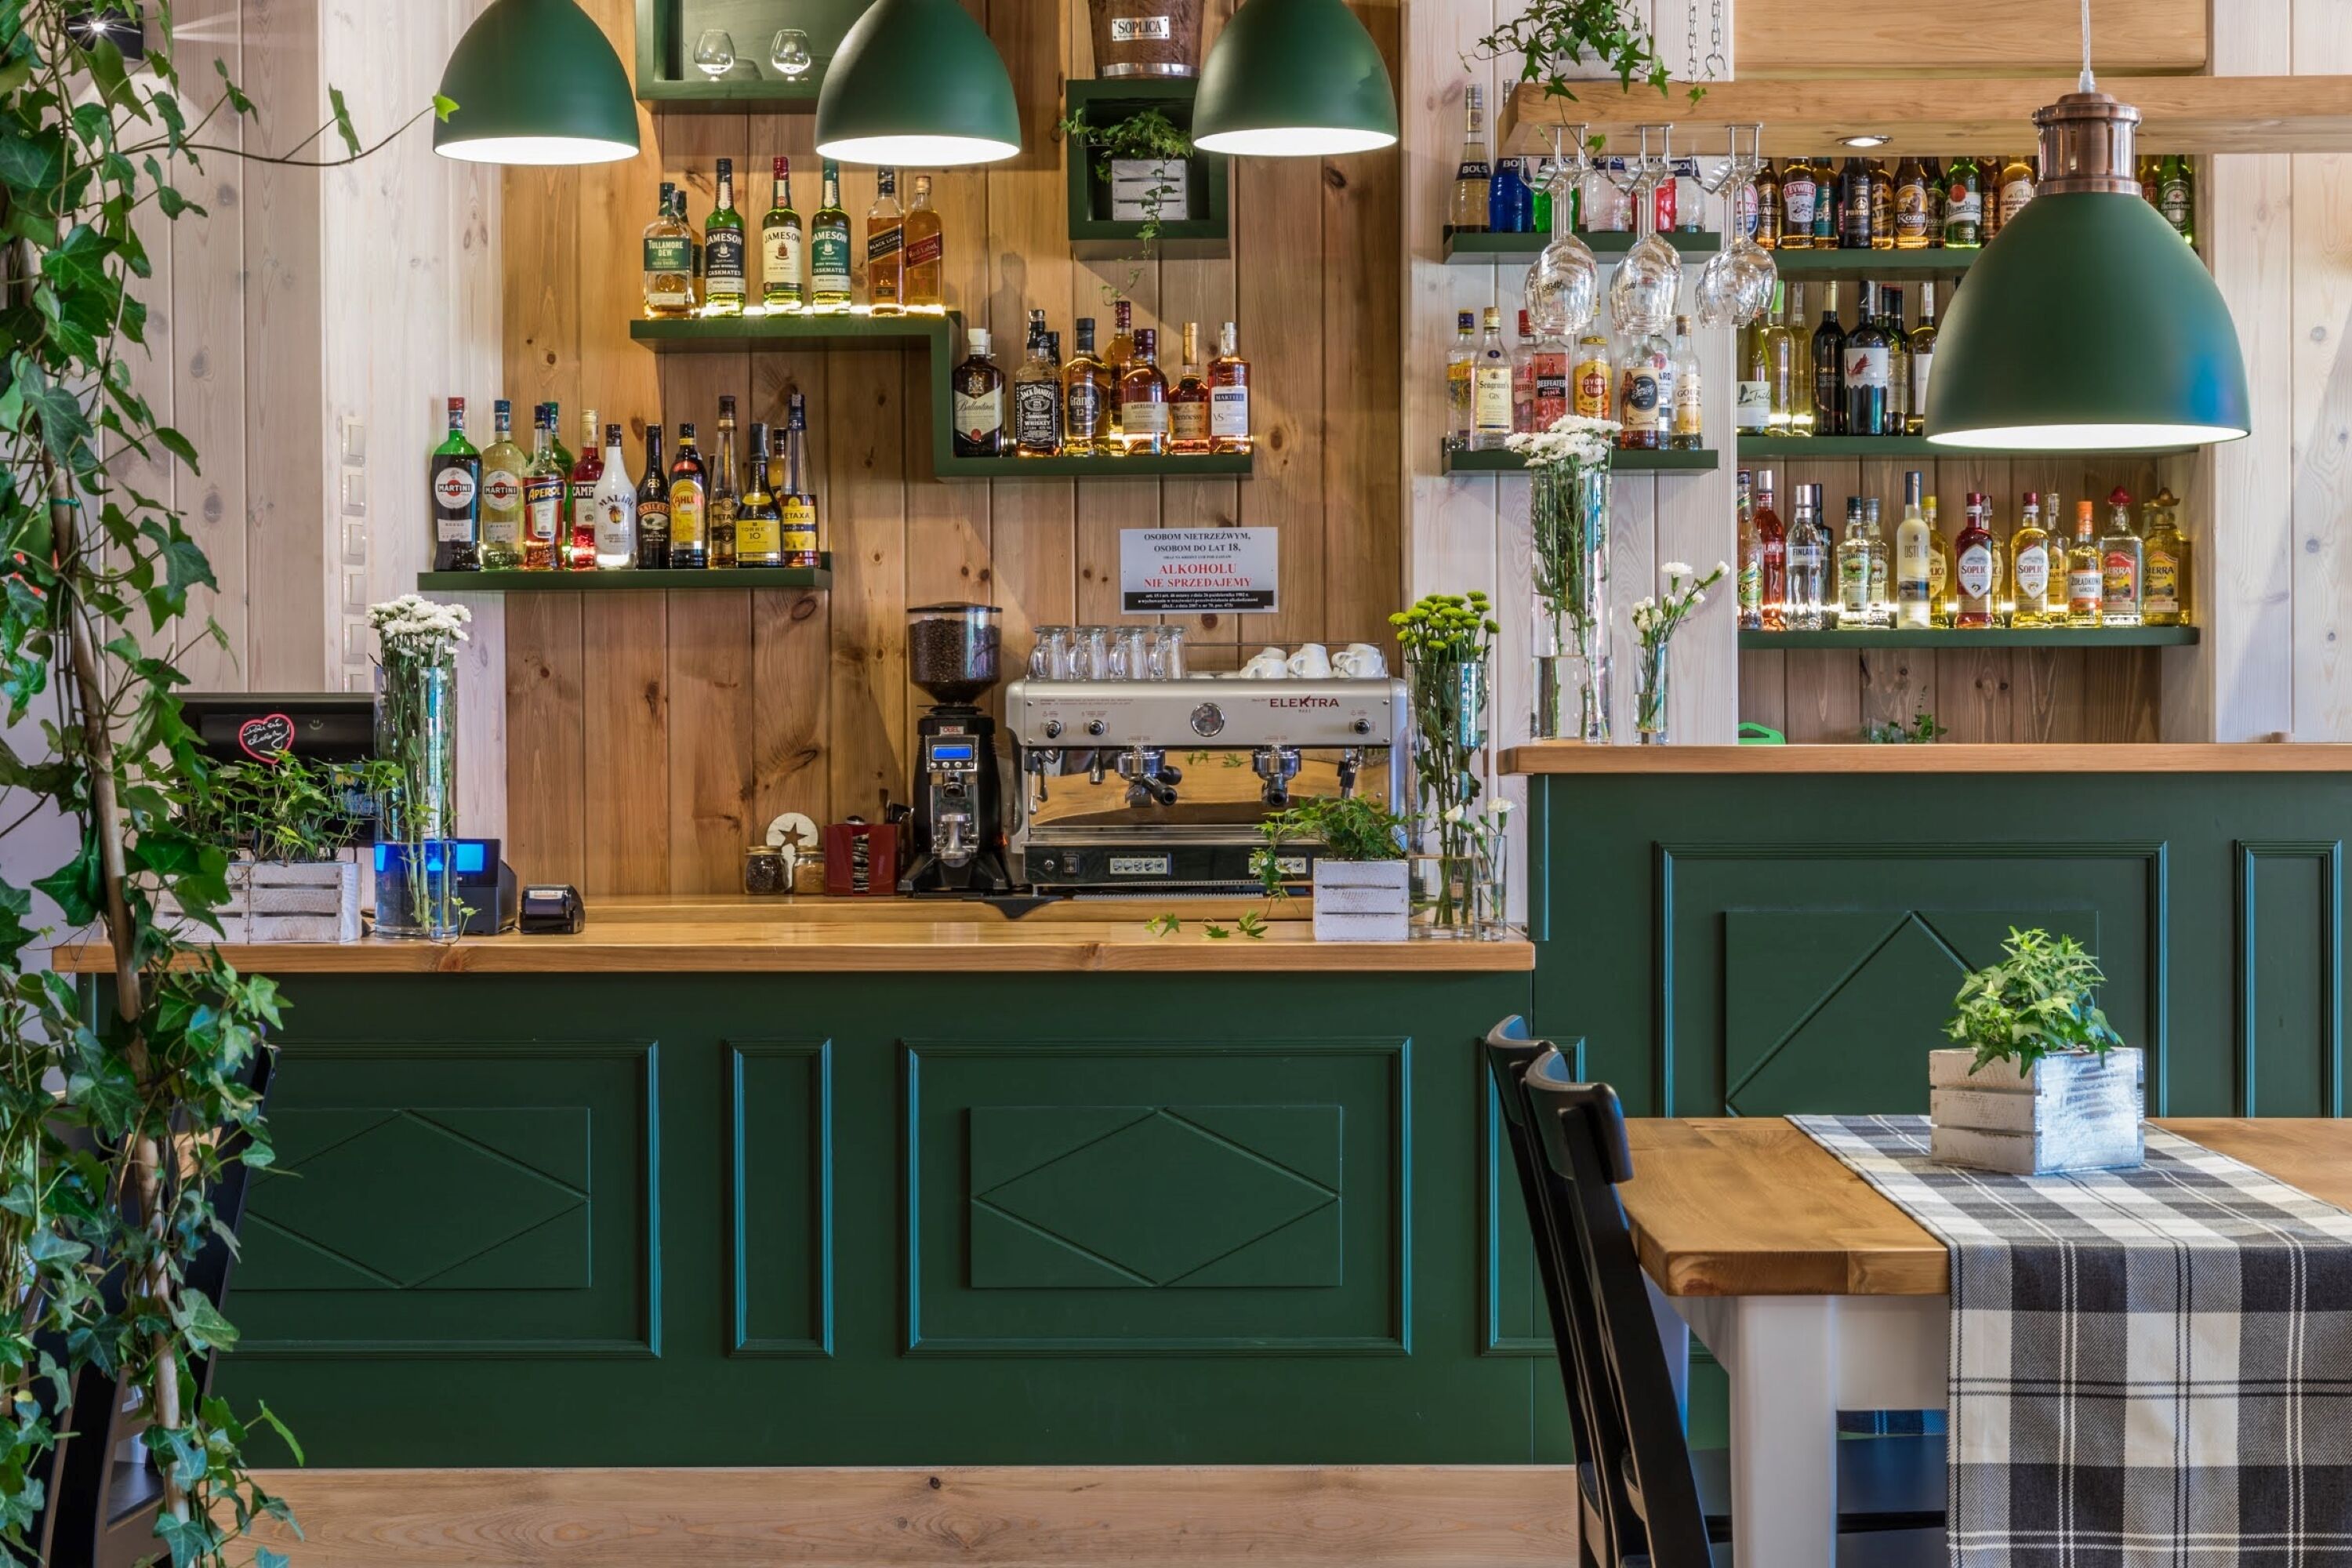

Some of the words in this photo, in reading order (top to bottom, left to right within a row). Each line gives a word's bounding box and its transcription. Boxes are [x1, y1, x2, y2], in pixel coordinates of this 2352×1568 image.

[1118, 21, 1162, 33] SOPLICA
[1897, 213, 1926, 223] Kozel
[706, 233, 742, 246] JAMESON
[764, 232, 800, 243] JAMESON
[811, 231, 848, 244] JAMESON
[648, 240, 684, 249] TULLAMORE
[1537, 379, 1566, 389] BEEFEATER
[1021, 389, 1033, 401] JACK
[1585, 386, 1602, 394] Club
[528, 485, 561, 500] APEROL
[573, 485, 594, 496] CAMP
[598, 495, 634, 510] MALIBU
[1229, 543, 1241, 553] 18,
[1793, 547, 1819, 556] FINLAN
[1904, 546, 1928, 557] OSTA
[1160, 563, 1237, 575] ALKOHOLU
[2104, 566, 2132, 575] IERRA
[2144, 566, 2174, 575] SIERRA
[1144, 579, 1164, 588] NIE
[1167, 578, 1252, 587] SPRZEDAJEMY
[1270, 695, 1339, 708] ELEKTRA
